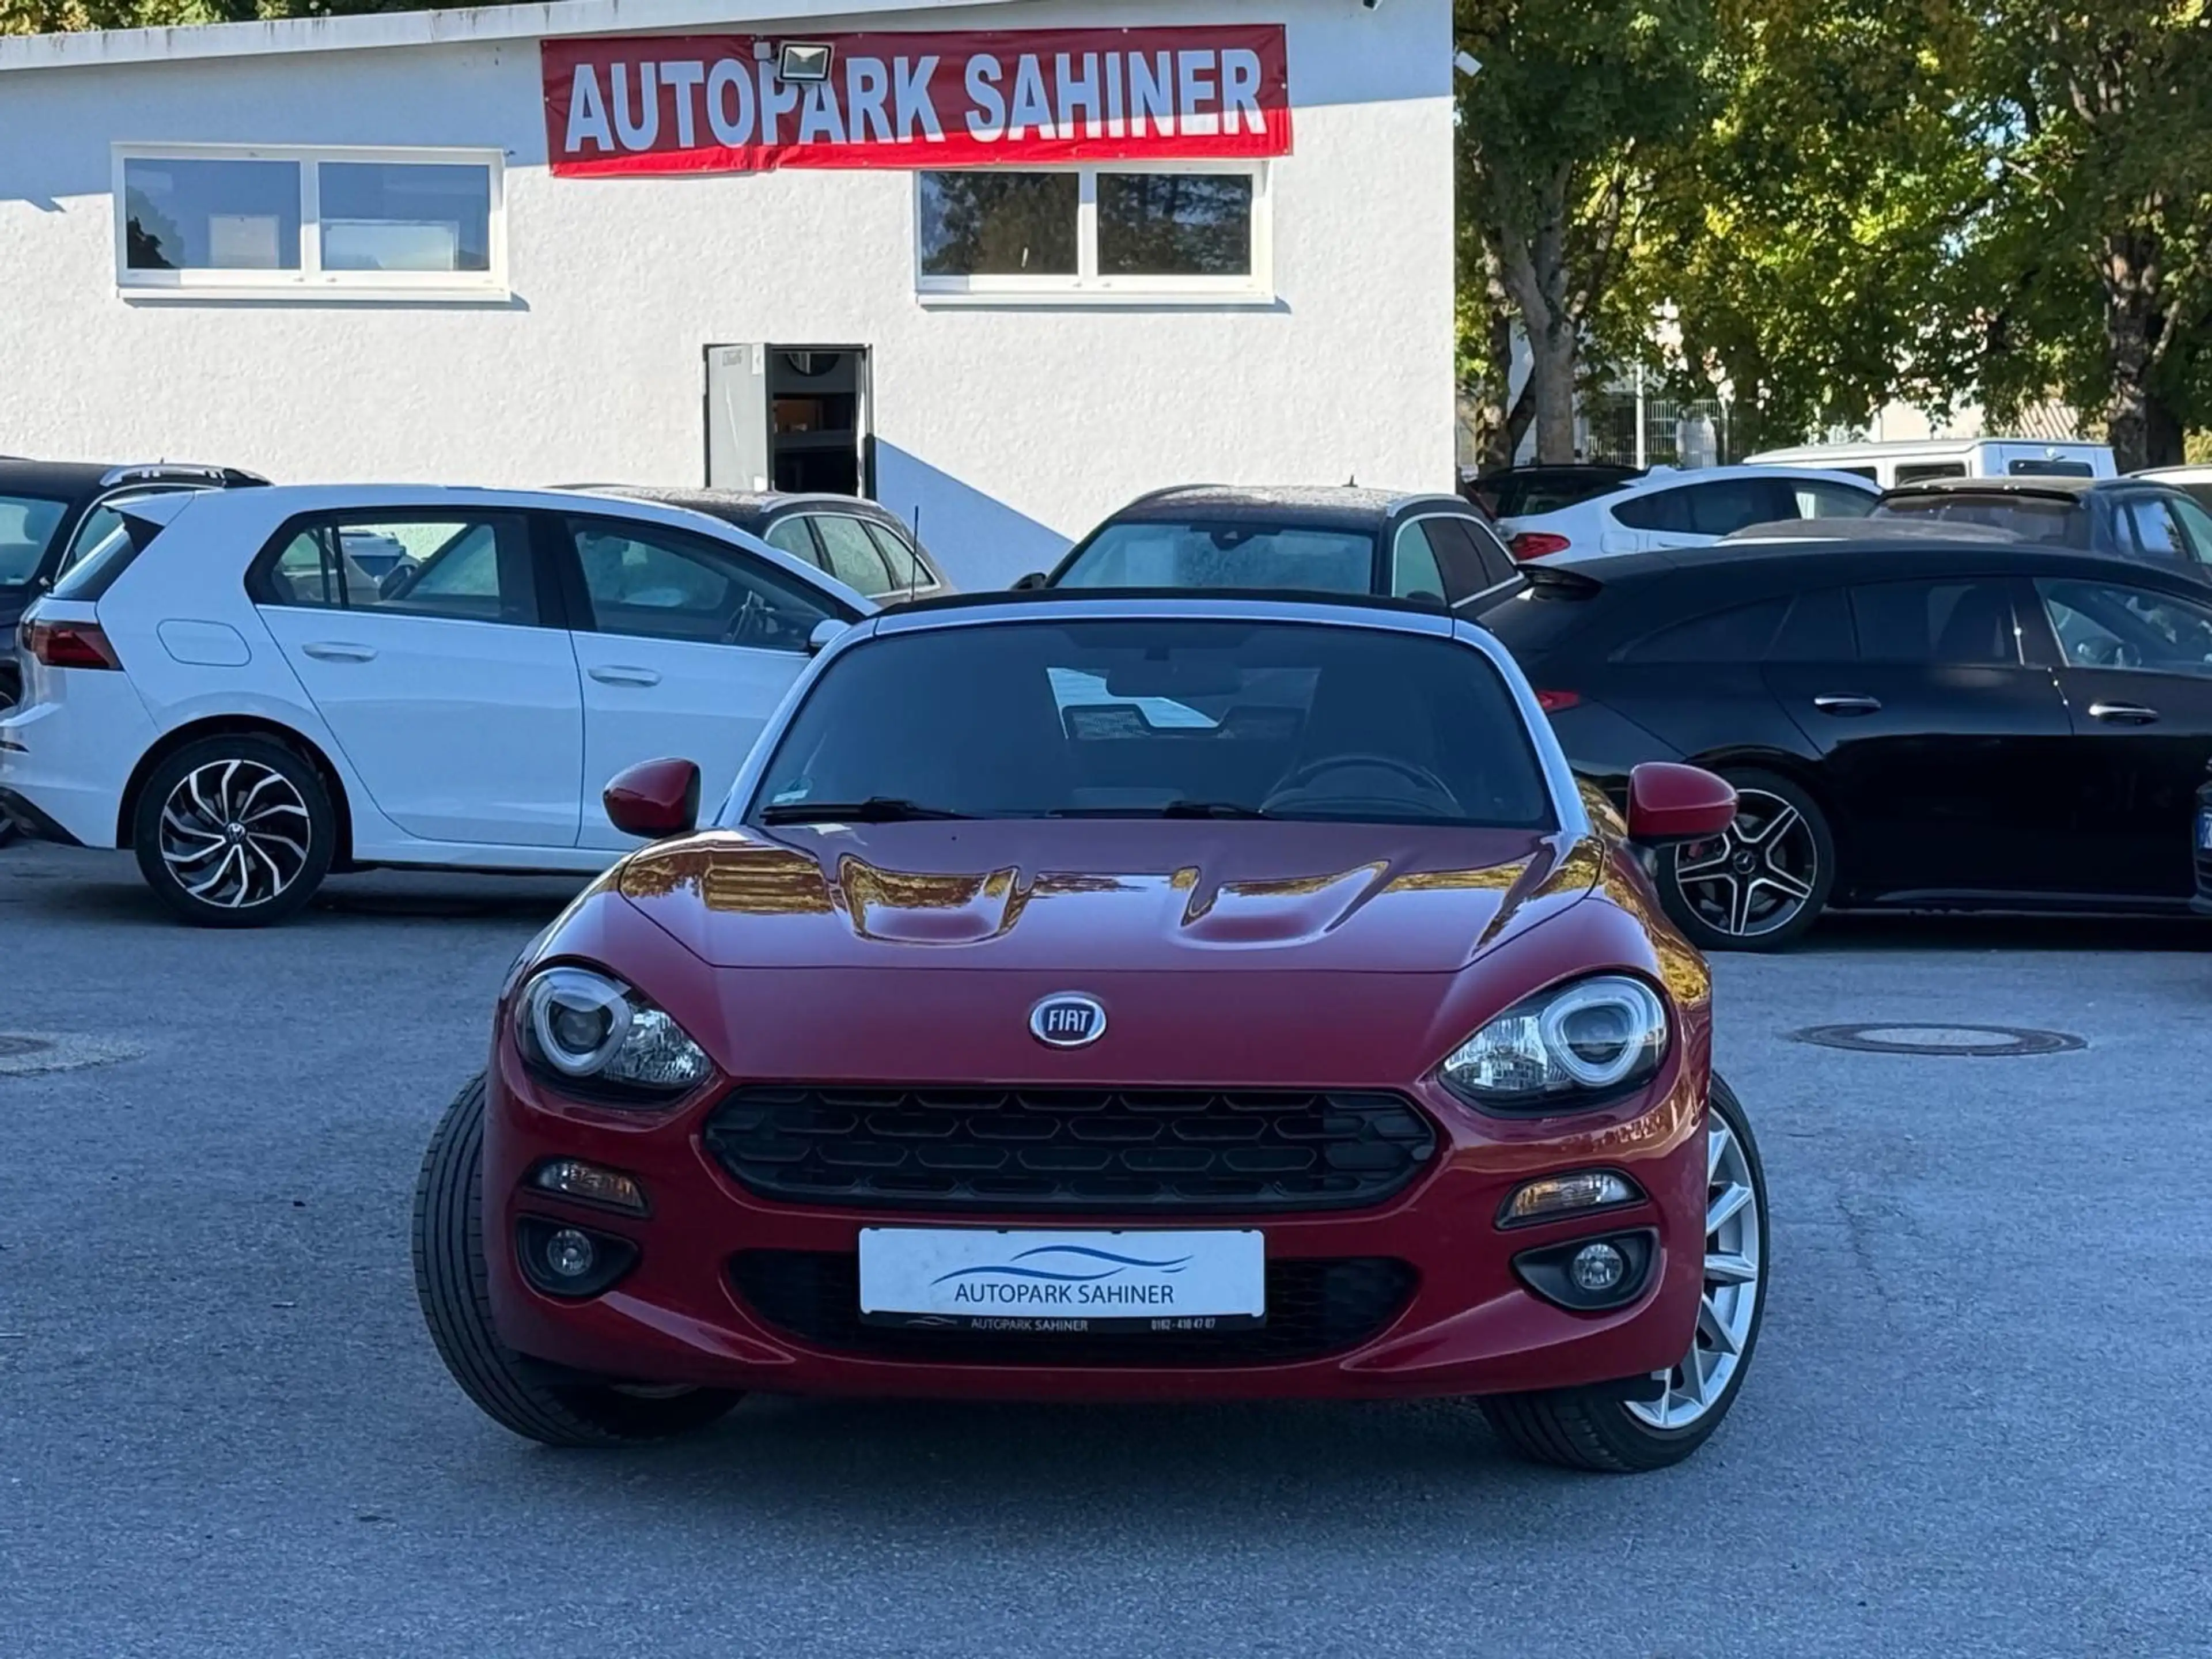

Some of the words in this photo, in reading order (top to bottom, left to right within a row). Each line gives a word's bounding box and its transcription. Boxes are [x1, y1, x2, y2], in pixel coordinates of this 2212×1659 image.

[564, 55, 945, 153] AUTOPARK
[964, 48, 1266, 141] SAHINER
[1047, 1009, 1092, 1032] FIAT
[955, 1283, 1072, 1304] AUTOPARK
[1078, 1284, 1174, 1304] SAHINER
[971, 1318, 1032, 1331] AUTOPARK
[1035, 1319, 1088, 1332] SAHINER
